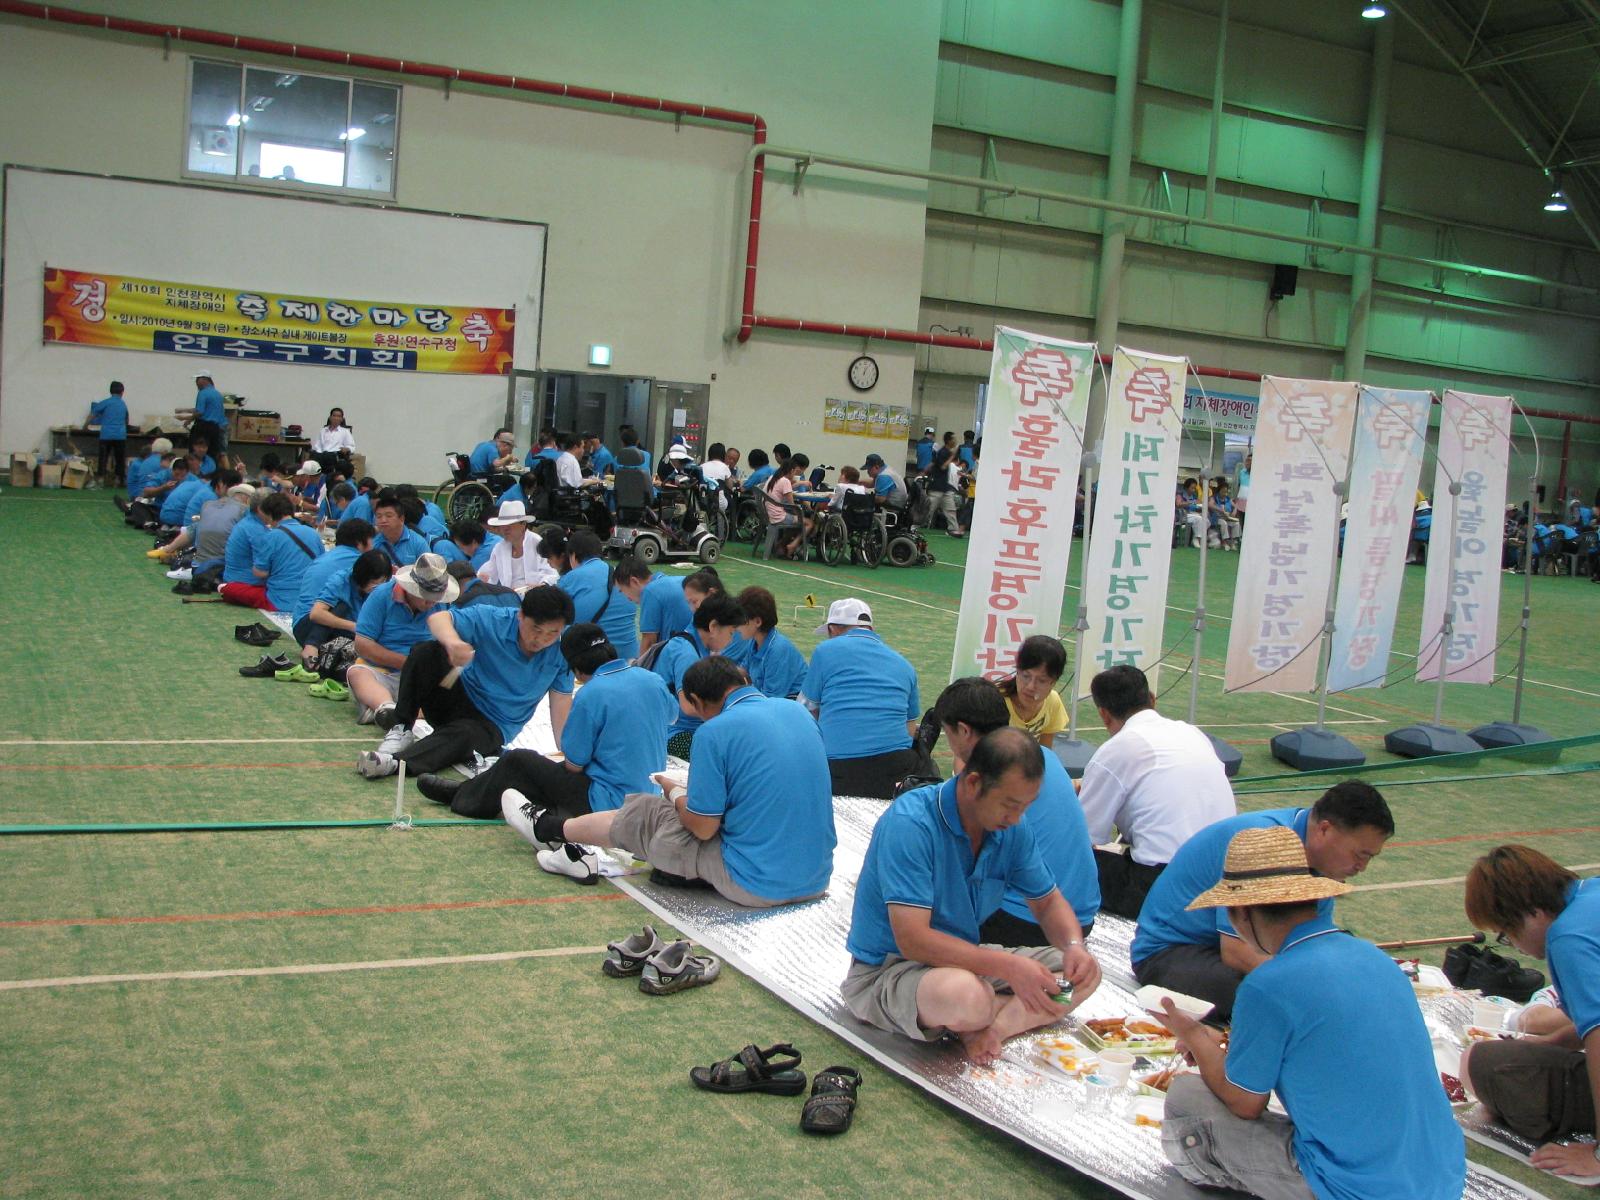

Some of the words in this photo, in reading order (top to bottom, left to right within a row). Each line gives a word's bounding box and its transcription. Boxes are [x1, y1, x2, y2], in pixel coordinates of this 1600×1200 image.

[71, 280, 107, 322] 경
[122, 282, 160, 295] 제10회
[166, 287, 225, 302] 인천광역시
[165, 299, 225, 312] 지체장애인
[282, 329, 300, 339] 실내
[461, 313, 494, 352] 축
